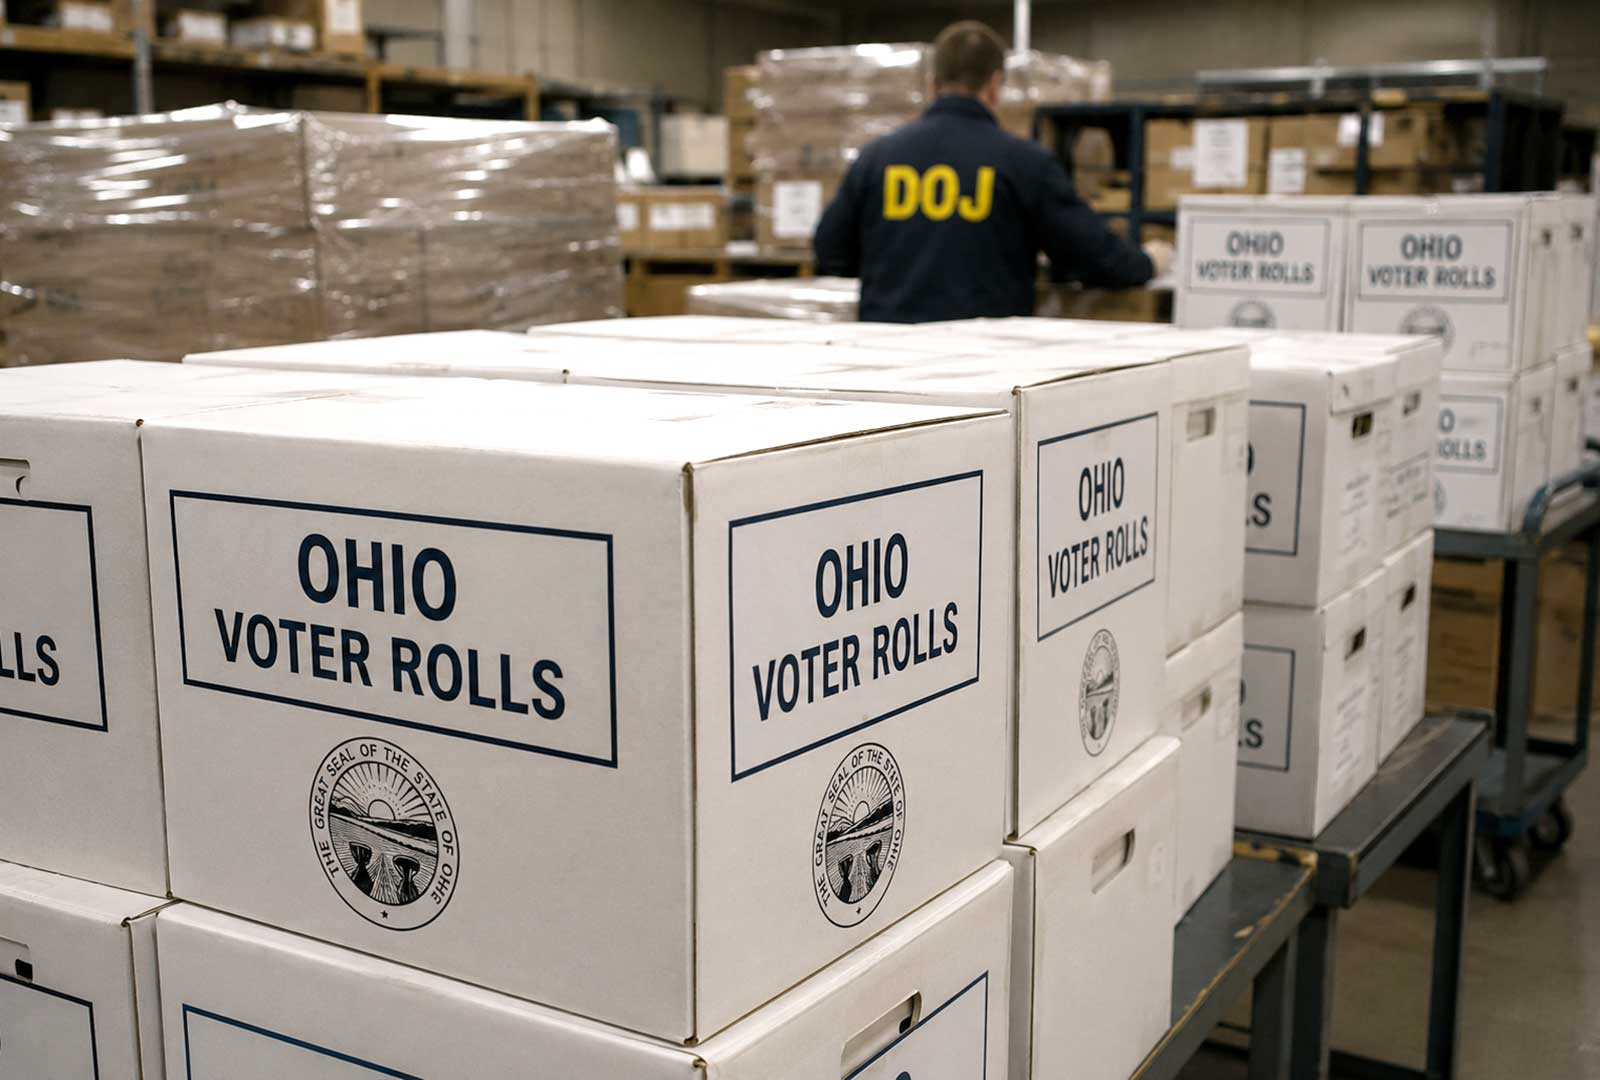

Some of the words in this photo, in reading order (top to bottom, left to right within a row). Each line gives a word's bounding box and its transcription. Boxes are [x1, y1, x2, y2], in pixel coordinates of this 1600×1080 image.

[883, 163, 995, 222] DOJ
[1226, 231, 1284, 256] OHIO
[1400, 234, 1462, 259] OHIO
[1197, 261, 1251, 281] VOTER
[1259, 263, 1314, 284] ROLLS
[1369, 266, 1428, 288] VOTER
[1435, 267, 1496, 289] ROLLS
[1079, 457, 1124, 521] OHIO
[298, 533, 457, 621] OHIO
[815, 532, 908, 618] OHIO
[1048, 536, 1100, 598] VOTER
[1105, 516, 1149, 573] ROLLS
[214, 608, 373, 687] VOTER
[391, 637, 566, 720] ROLLS
[752, 634, 861, 721] VOTER
[873, 601, 958, 680] ROLLS
[326, 748, 356, 777] SEAL
[359, 743, 377, 758] OF
[383, 747, 410, 773] THE
[314, 776, 330, 830] GREAT
[413, 771, 447, 822] STATE
[441, 830, 454, 856] OF
[817, 873, 831, 907] THE
[828, 767, 849, 803] SEAL
[851, 750, 864, 769] OF
[867, 749, 884, 766] THE
[883, 758, 901, 797] STATE
[894, 800, 903, 822] OF
[318, 840, 340, 878] THE
